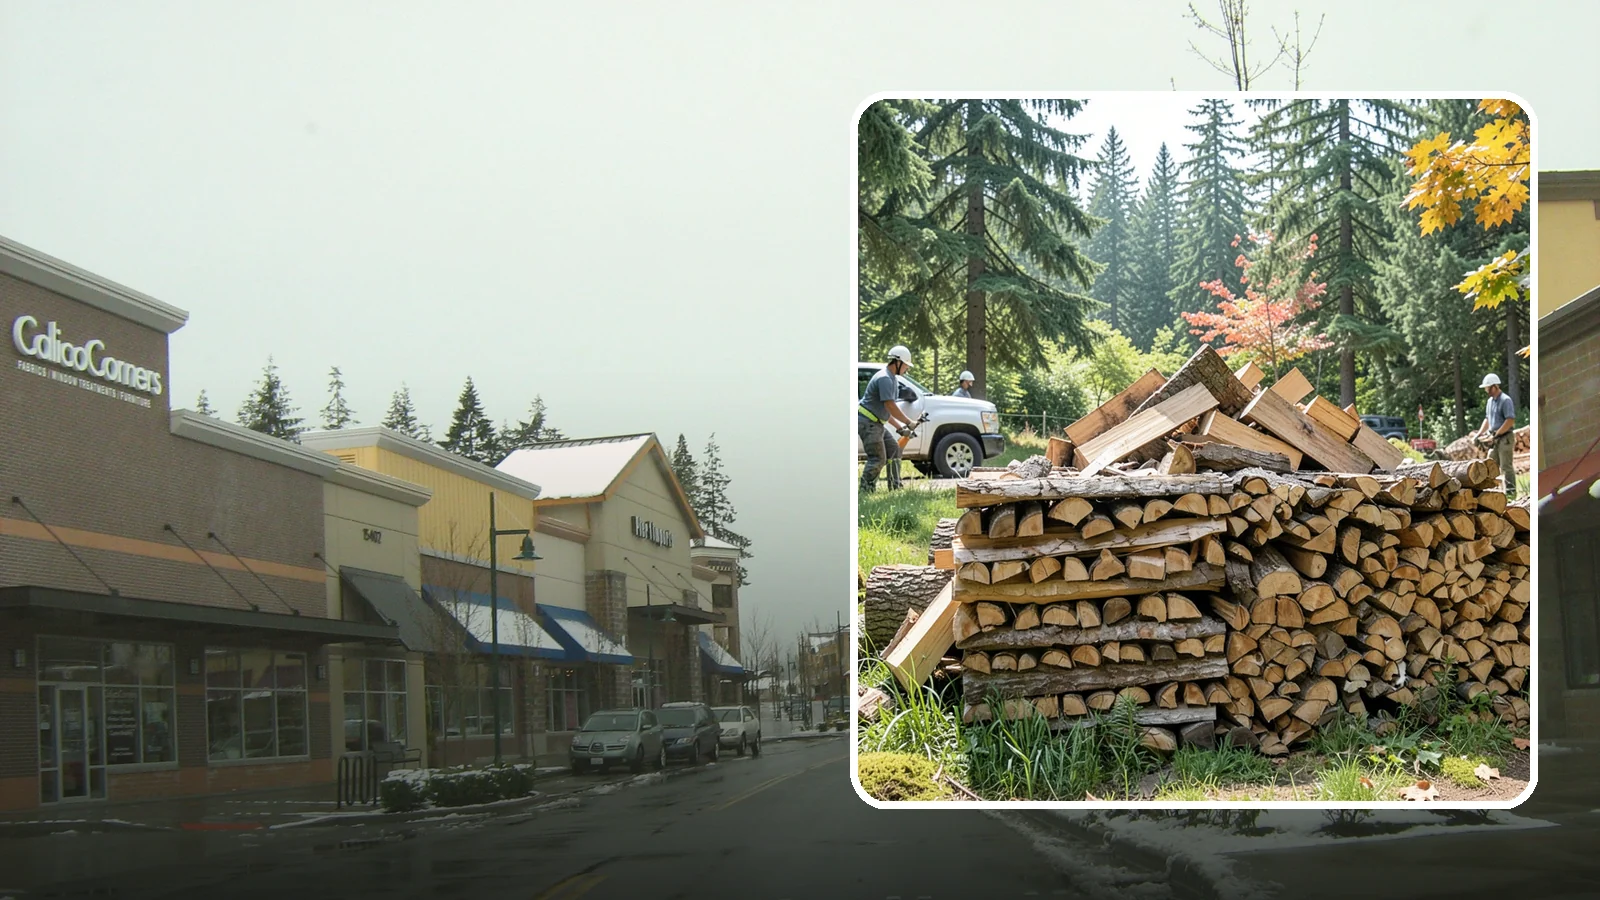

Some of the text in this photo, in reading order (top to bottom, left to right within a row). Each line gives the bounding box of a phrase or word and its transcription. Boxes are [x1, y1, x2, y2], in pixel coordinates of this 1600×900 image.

[16, 359, 151, 409] FABRICS WINDOW TREATMENTS FURNITURE
